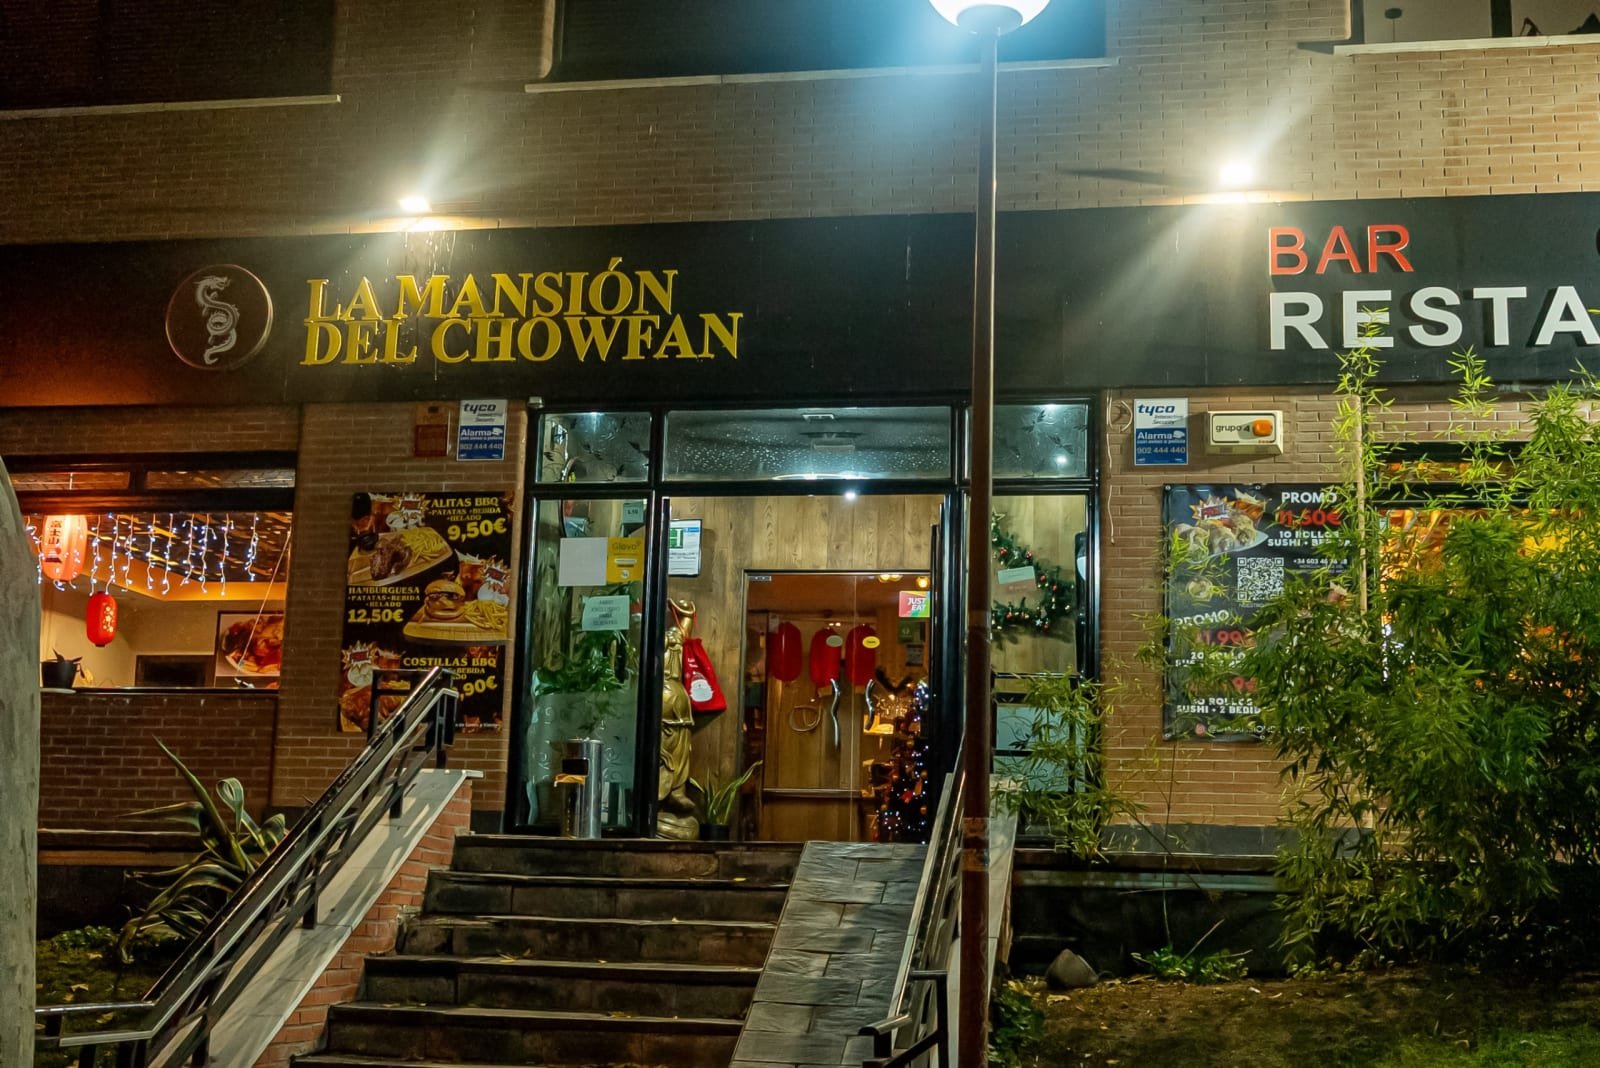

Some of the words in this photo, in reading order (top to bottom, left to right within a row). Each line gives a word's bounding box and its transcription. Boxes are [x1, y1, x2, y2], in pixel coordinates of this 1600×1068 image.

[1268, 224, 1414, 276] BAR
[306, 275, 383, 323] LA
[395, 256, 679, 319] MANSIÓN
[1269, 286, 1600, 350] RESTA
[299, 317, 418, 366] DEL
[431, 312, 744, 363] CHOWFAN
[463, 402, 497, 414] tyco
[1137, 404, 1175, 416] tyco
[460, 427, 492, 437] Alarma
[1215, 424, 1242, 433] grupo
[1137, 431, 1173, 439] Alarma
[431, 498, 472, 508] ALITAS
[475, 497, 499, 507] BBQ
[1281, 492, 1338, 504] PROMO
[447, 517, 508, 542] 9,50€
[1267, 538, 1301, 547] SUSHI
[348, 586, 420, 595] HAMBURGUESA
[907, 597, 926, 606] JUST
[347, 608, 404, 624] 12,50€
[403, 656, 468, 667] COSTILLAS
[471, 656, 497, 668] BBQ
